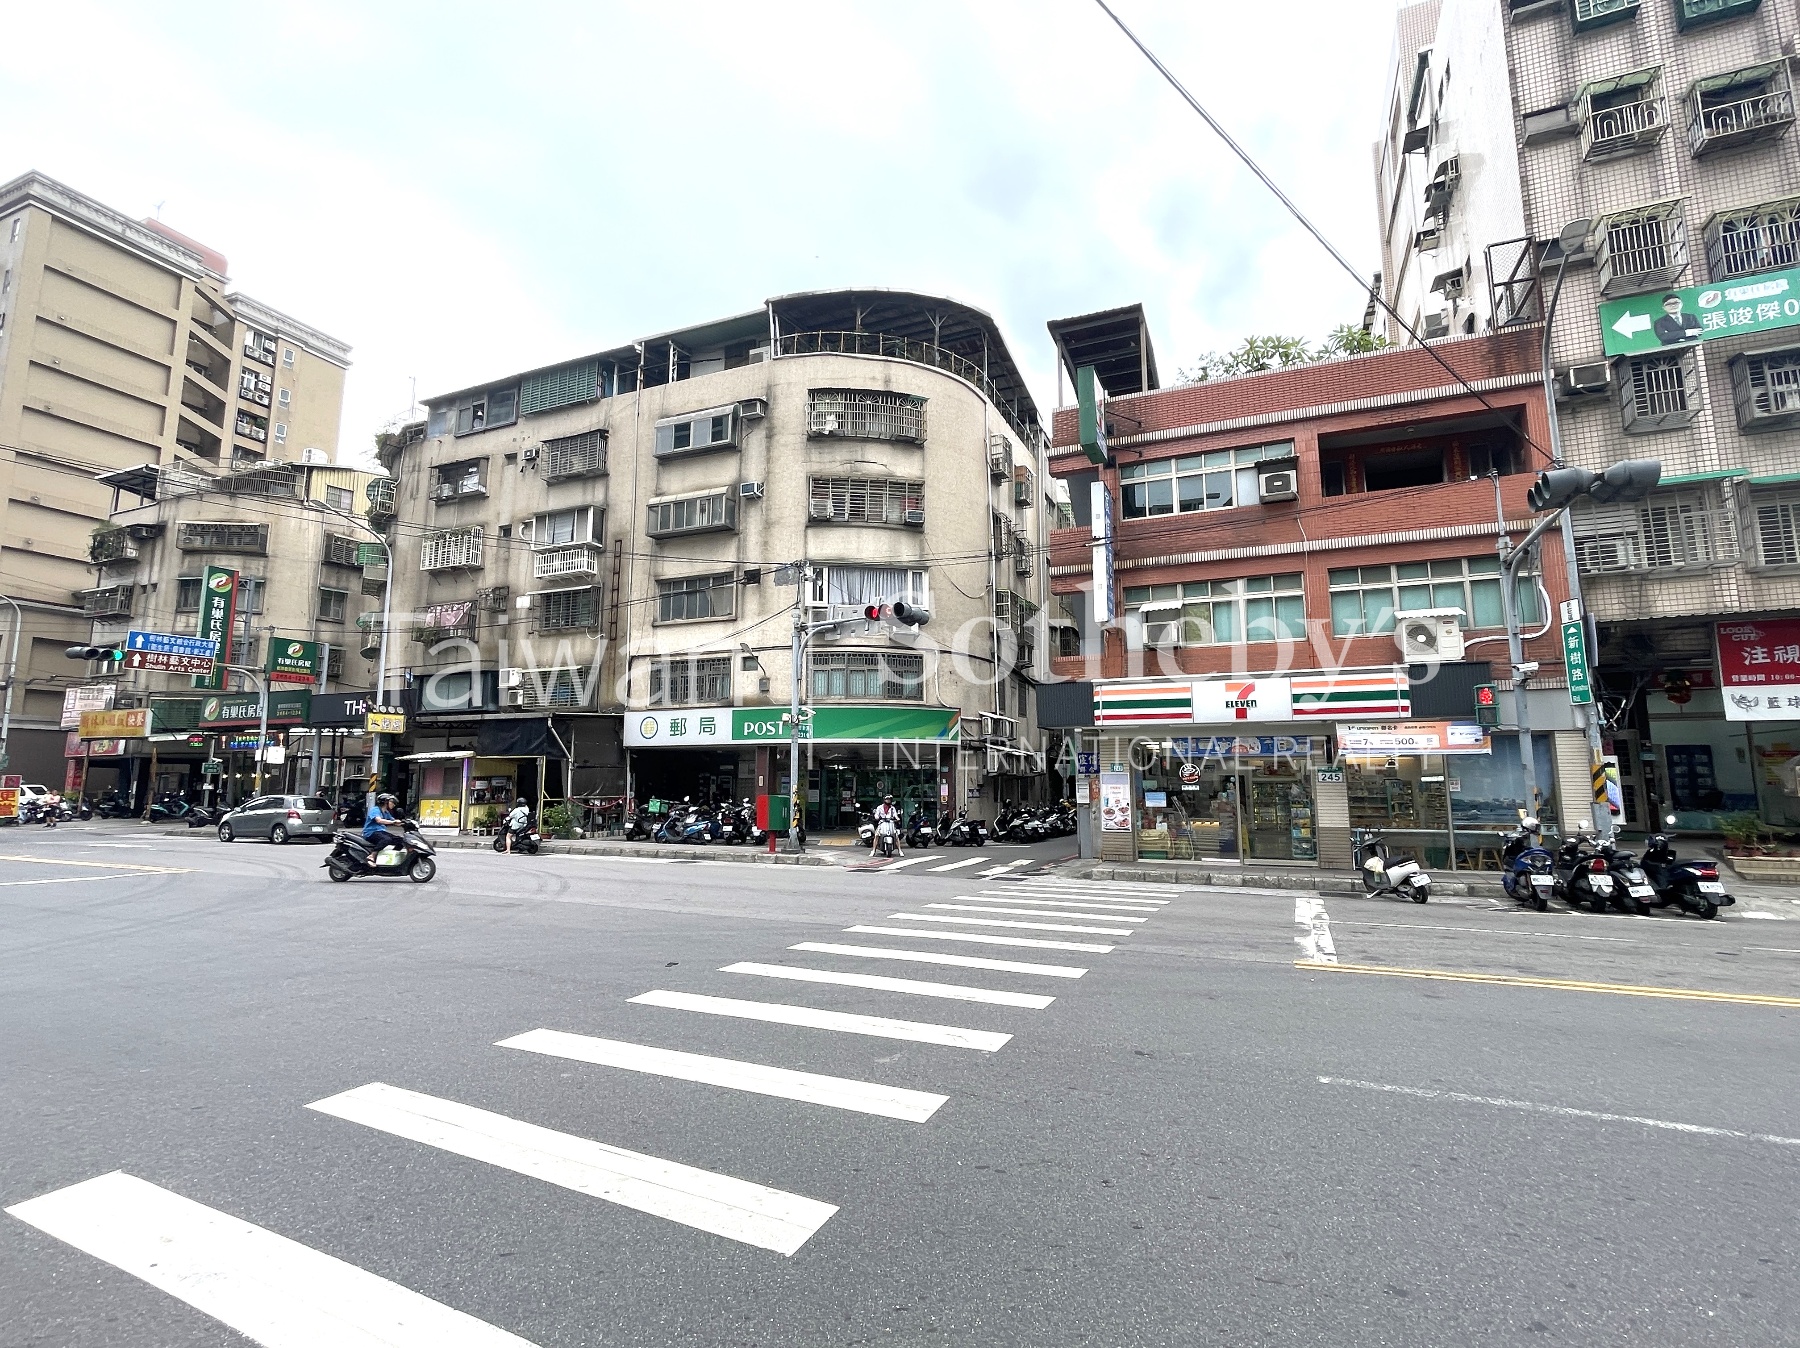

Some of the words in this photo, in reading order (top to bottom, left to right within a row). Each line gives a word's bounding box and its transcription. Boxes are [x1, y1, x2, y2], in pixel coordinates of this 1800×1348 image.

[1702, 301, 1781, 331] 張竣傑
[146, 654, 211, 667] 樹林藝文中心
[1568, 636, 1584, 682] 新樹路
[1731, 674, 1766, 682] 營業時間
[670, 717, 716, 737] 郵局
[743, 721, 784, 736] POST
[1321, 773, 1341, 782] 245
